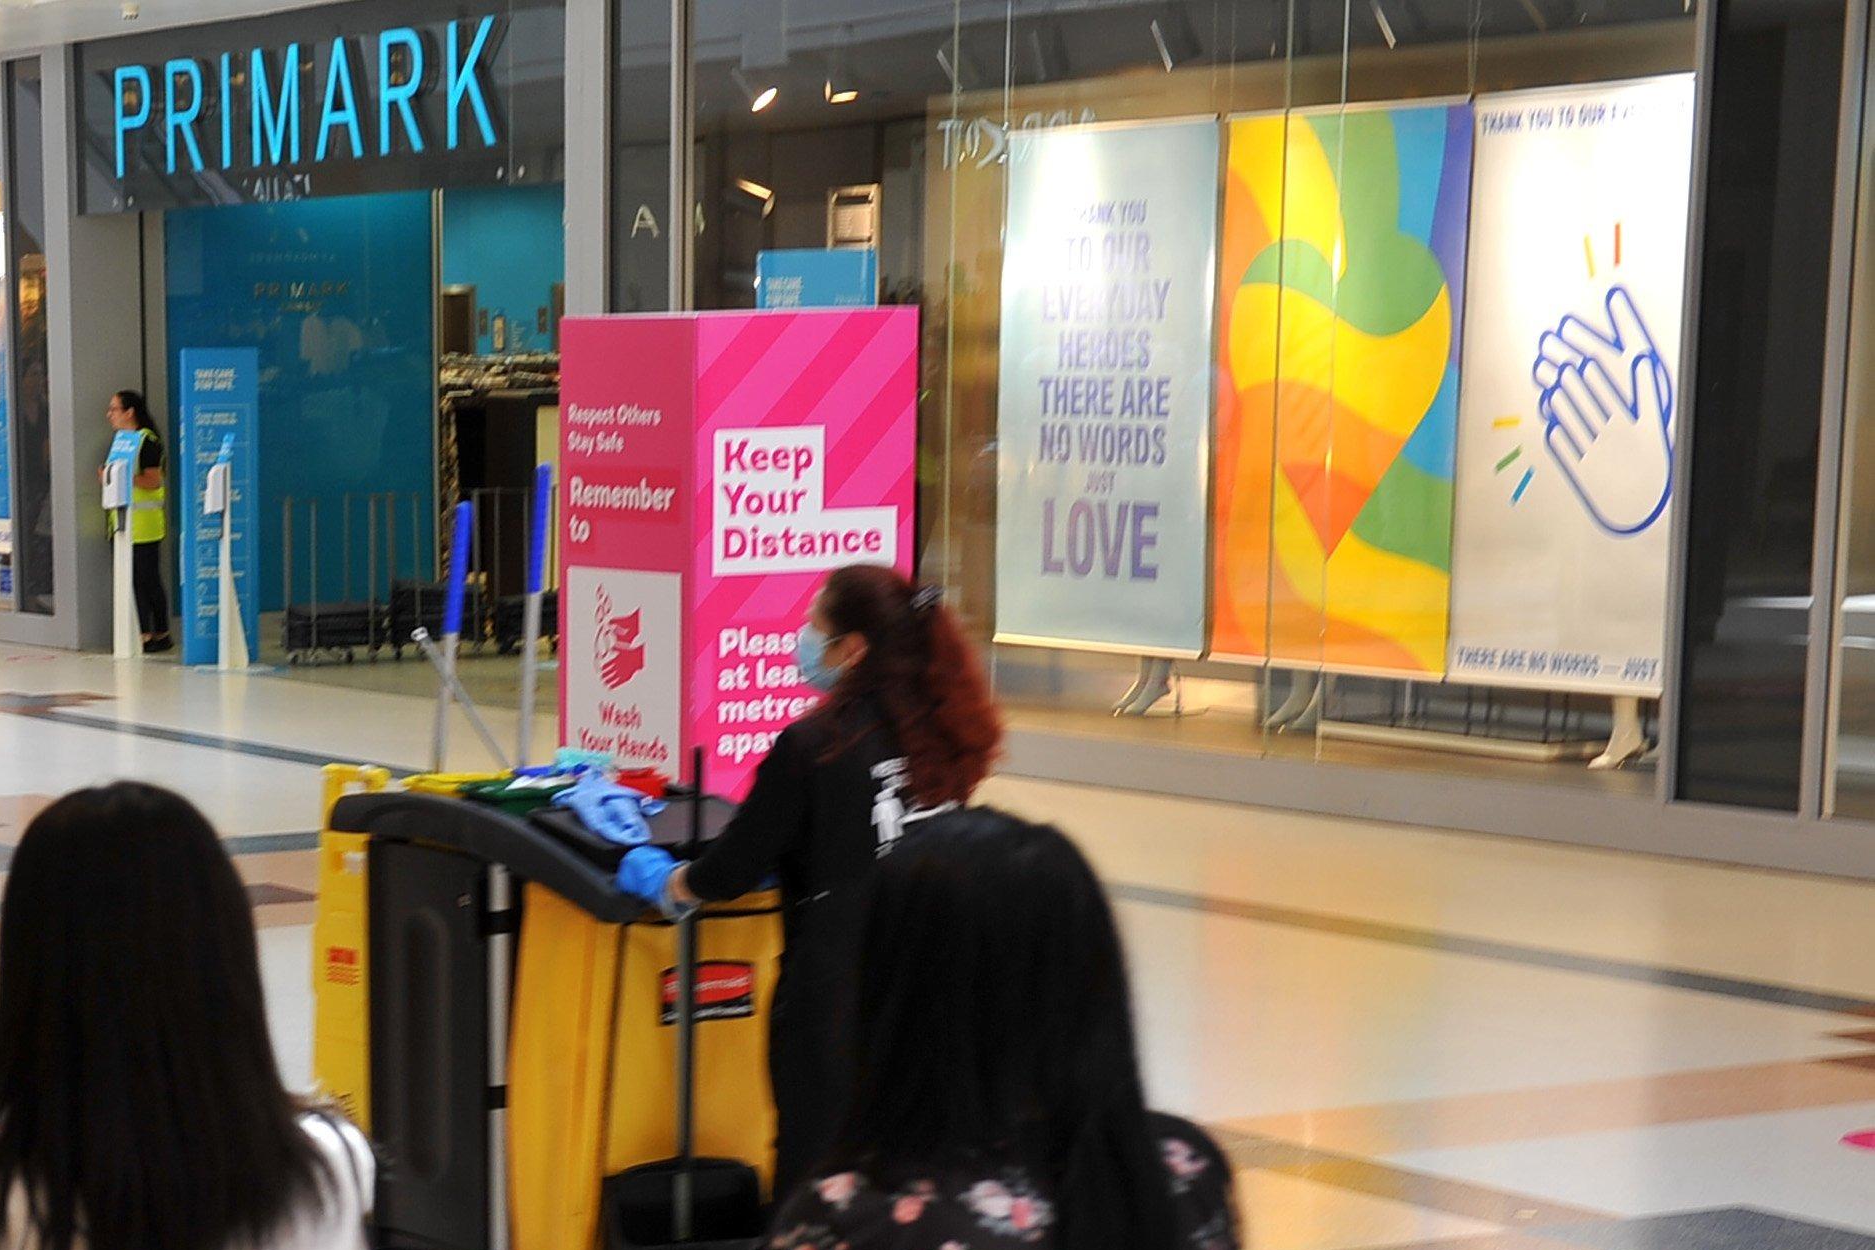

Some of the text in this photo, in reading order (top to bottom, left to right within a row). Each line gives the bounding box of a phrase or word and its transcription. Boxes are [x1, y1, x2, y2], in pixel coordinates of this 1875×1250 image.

[113, 14, 497, 180] PRIMARK
[1102, 231, 1151, 273] OUR
[1058, 328, 1151, 370] HEROES
[1039, 377, 1171, 416] THERE ARE
[568, 403, 662, 430] Respect Others
[568, 431, 624, 457] Stay Safe
[723, 438, 814, 480] Keep
[1039, 424, 1166, 464] NO WORDS
[570, 476, 675, 512] Remember
[1085, 472, 1116, 494] JUST
[724, 484, 807, 516] Your
[569, 514, 591, 543] to
[724, 526, 882, 559] Distance
[1042, 499, 1159, 580] LOVE
[719, 626, 799, 658] Pleas
[718, 658, 807, 690] at lea
[600, 702, 641, 727] Wash
[580, 727, 668, 760] Your Hands
